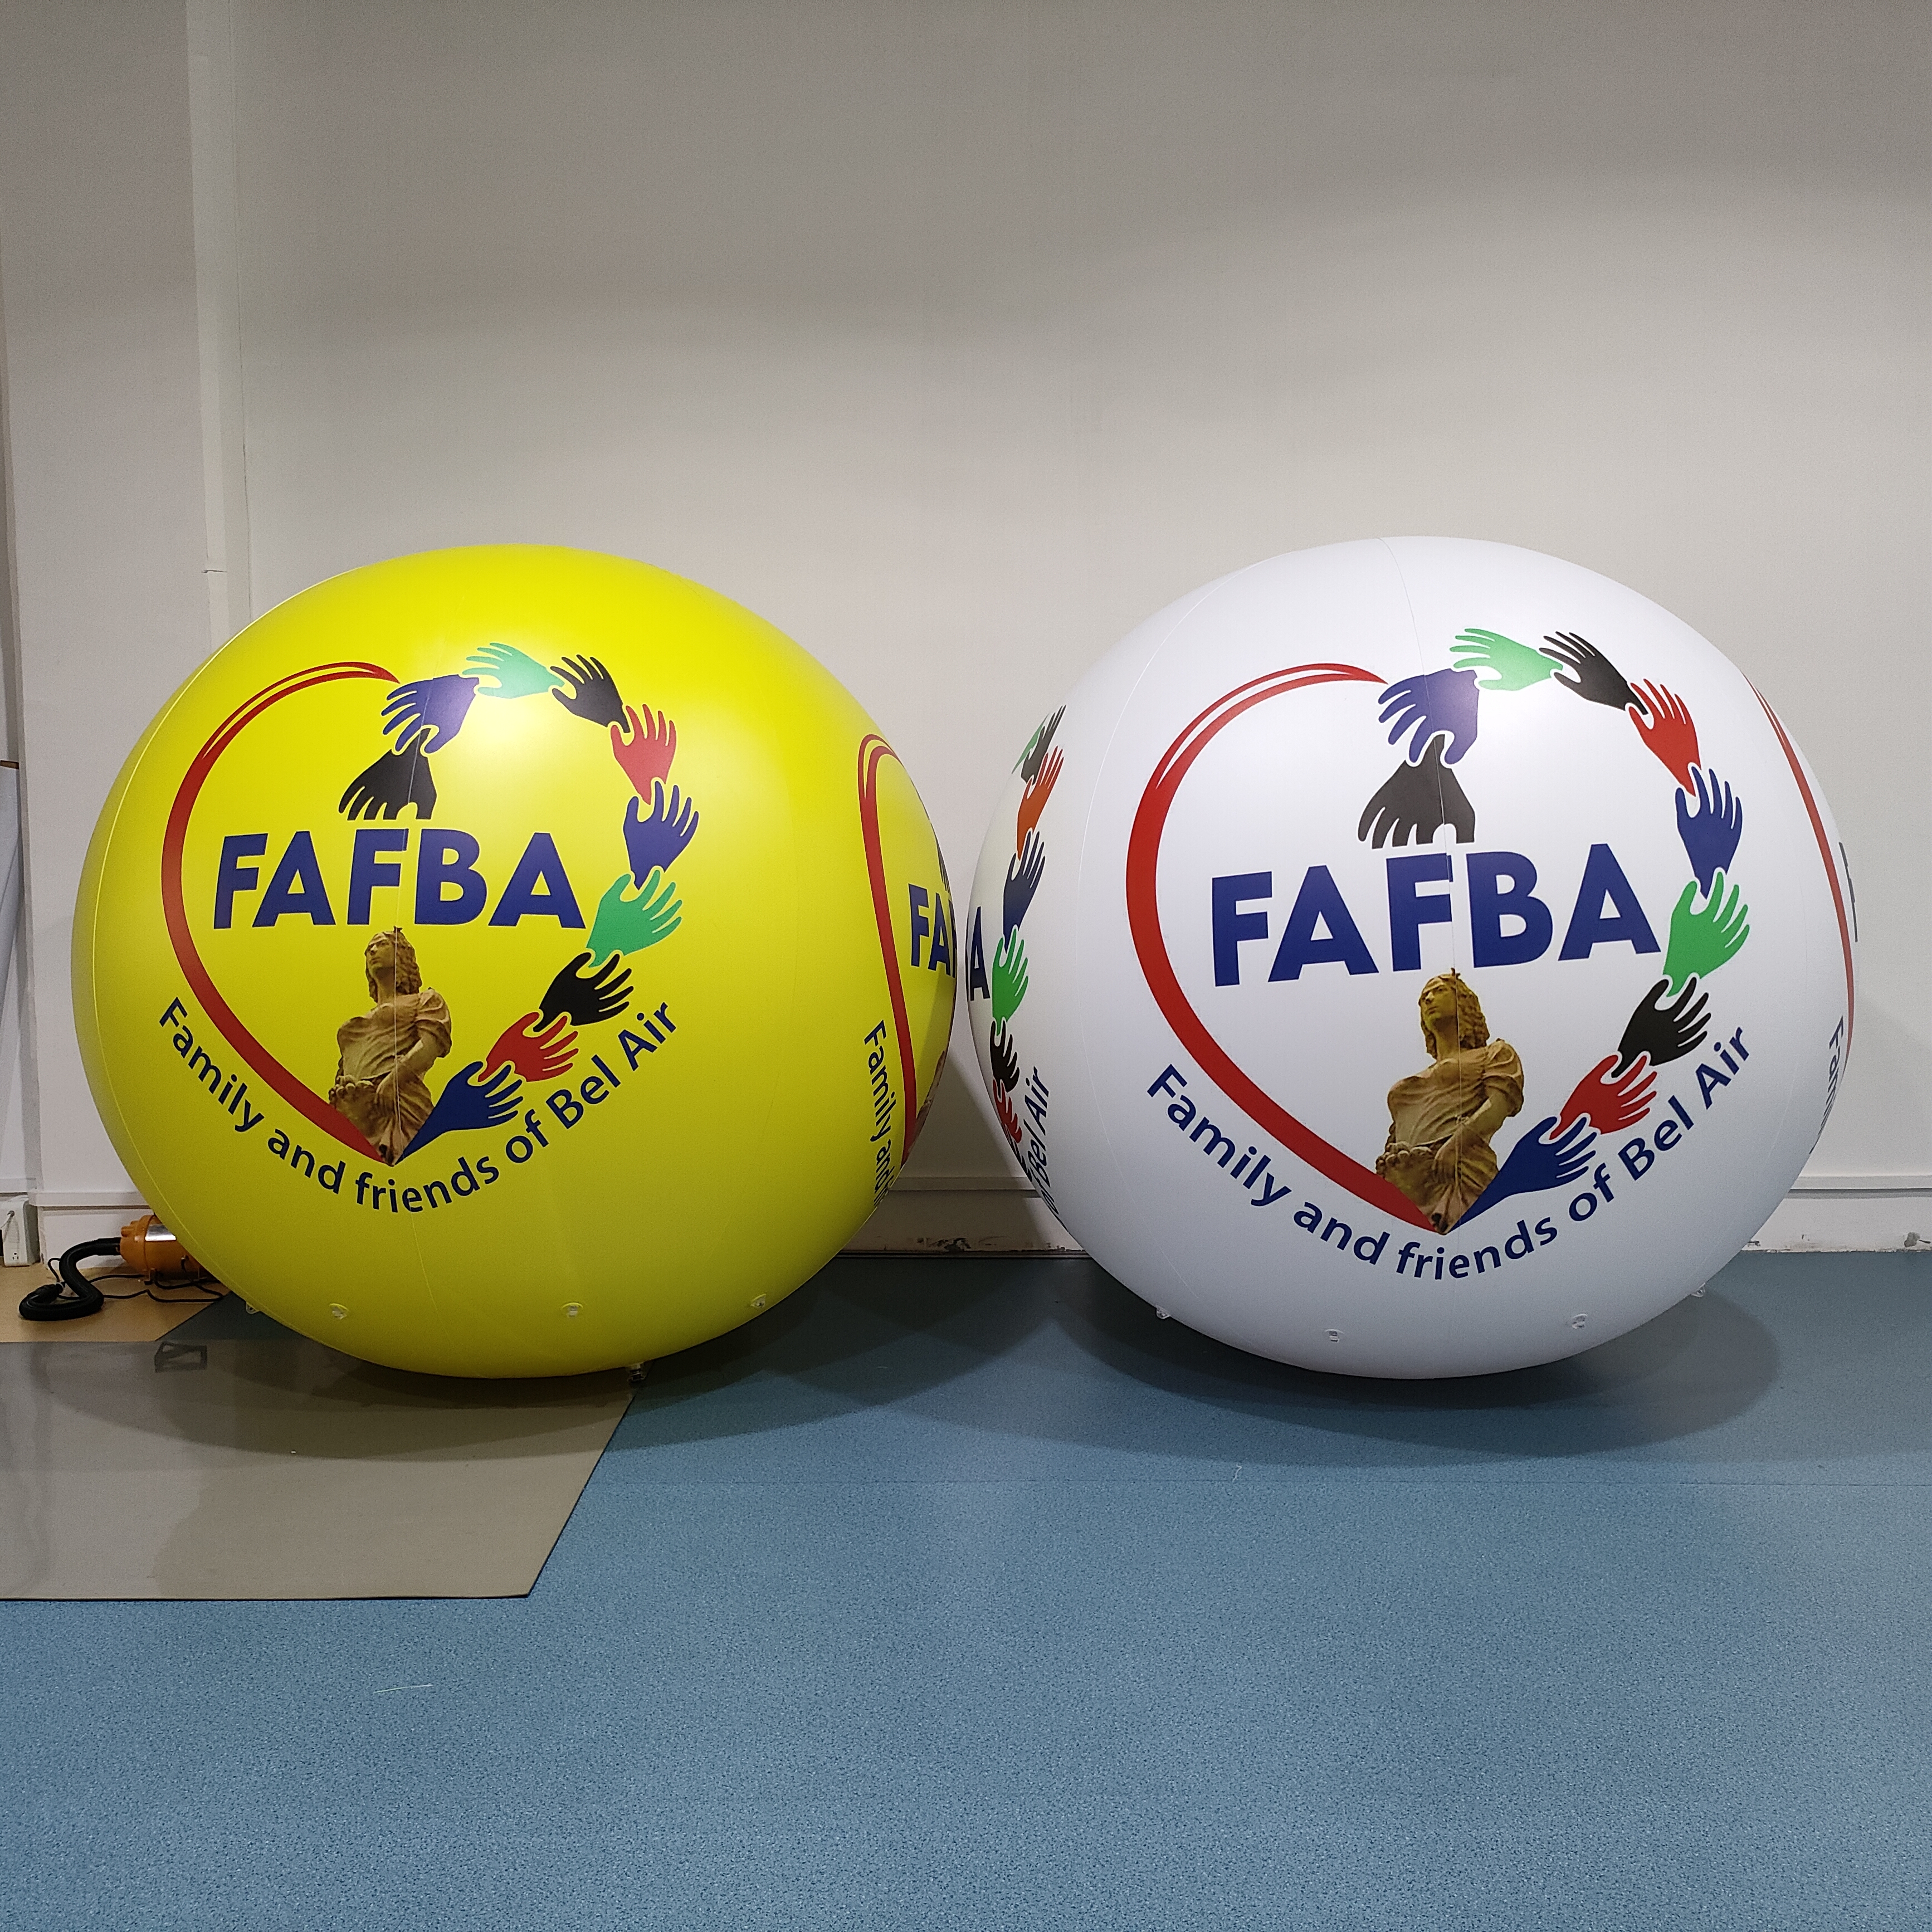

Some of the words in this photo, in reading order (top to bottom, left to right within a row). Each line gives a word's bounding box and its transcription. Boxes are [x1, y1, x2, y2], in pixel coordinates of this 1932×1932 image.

[214, 828, 586, 930] FAFBA
[1212, 843, 1661, 987] FAFBA
[159, 997, 265, 1133] Family
[267, 1129, 346, 1194] and
[355, 1156, 499, 1213] friends
[505, 1109, 549, 1163] of
[545, 1054, 621, 1130] Bel
[618, 1002, 676, 1072] Air
[864, 1019, 896, 1142] Family
[1024, 1066, 1049, 1136] Air
[874, 1139, 895, 1194] and
[1023, 1119, 1051, 1188] Bel
[1146, 1063, 1292, 1207] Family
[1293, 1202, 1391, 1265] and
[1396, 1217, 1558, 1281] friends
[1569, 1162, 1614, 1222] of
[1617, 1095, 1694, 1181] Bel
[1695, 1027, 1749, 1110] Air
